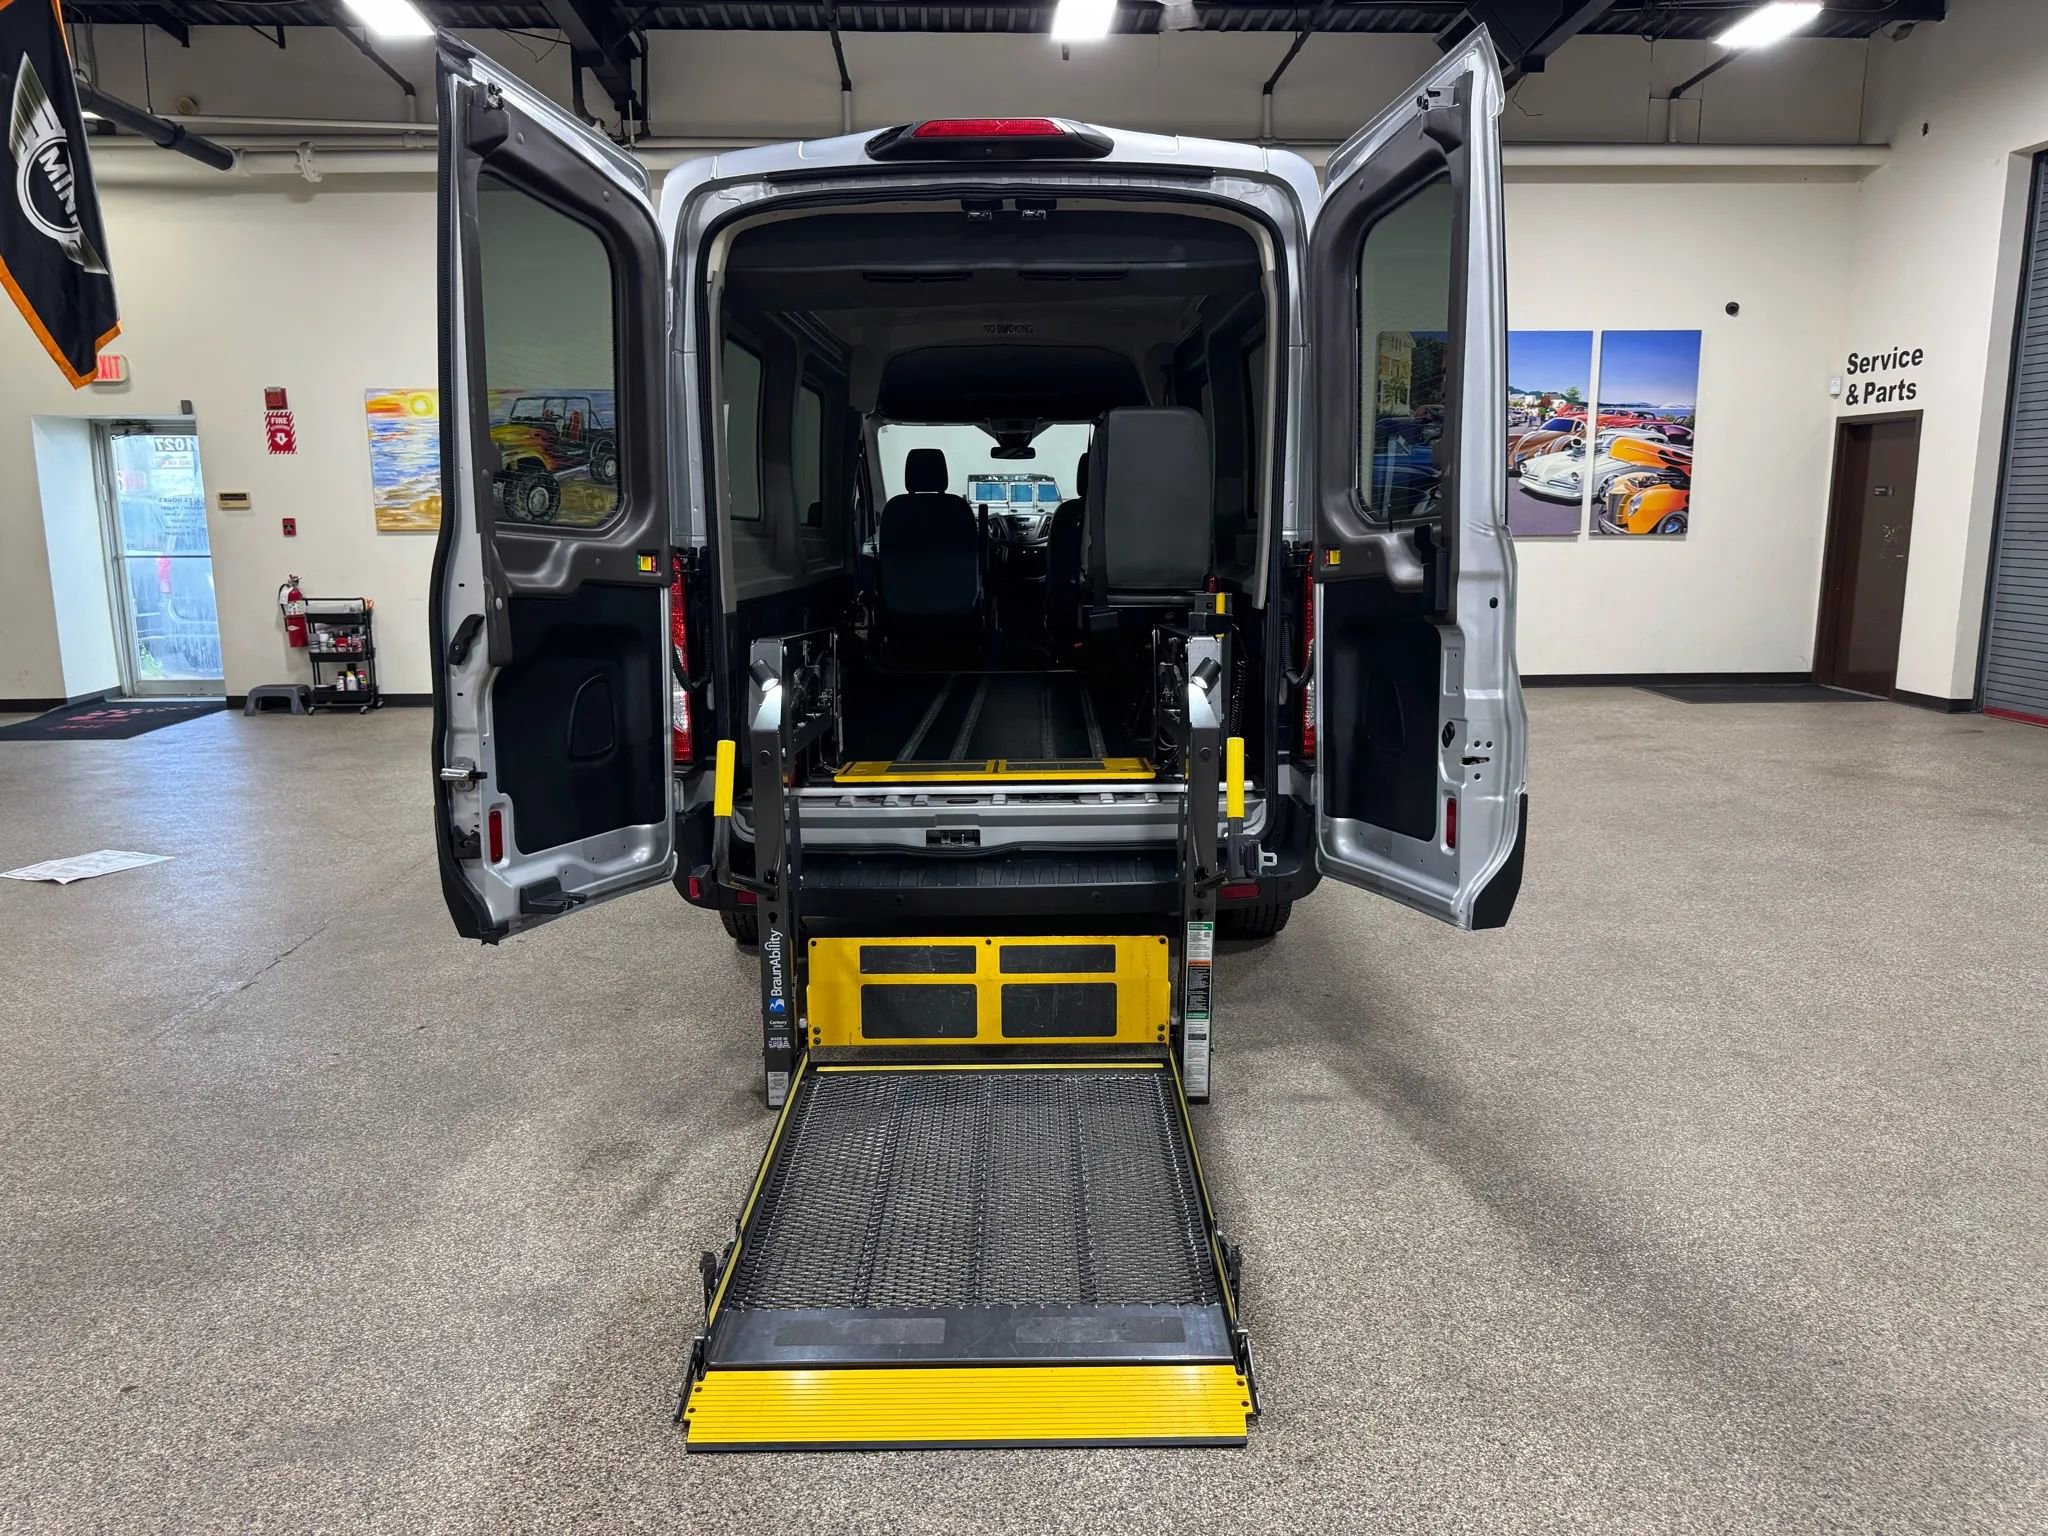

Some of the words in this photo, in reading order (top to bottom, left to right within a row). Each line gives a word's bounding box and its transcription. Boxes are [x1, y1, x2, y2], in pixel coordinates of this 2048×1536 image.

[984, 323, 996, 334] NO
[997, 323, 1034, 334] SMOKING
[97, 355, 120, 378] XIT
[1847, 346, 1924, 375] Service
[1846, 383, 1859, 406] &
[1863, 378, 1917, 404] Parts
[271, 417, 288, 425] FIRE
[764, 929, 783, 997] BraunAbility
